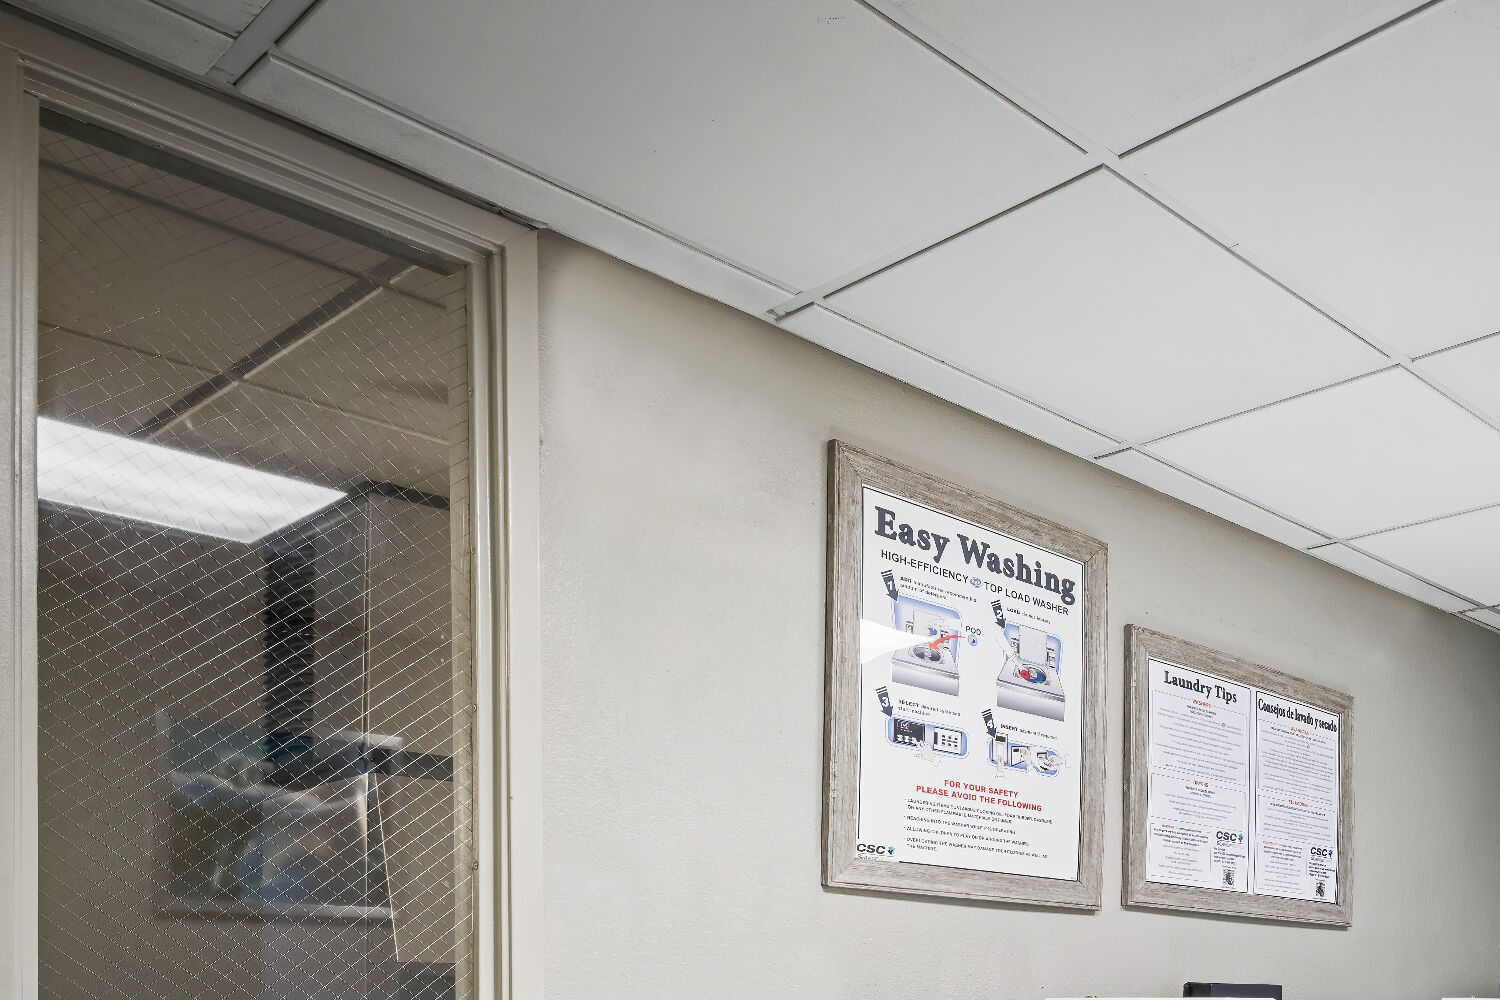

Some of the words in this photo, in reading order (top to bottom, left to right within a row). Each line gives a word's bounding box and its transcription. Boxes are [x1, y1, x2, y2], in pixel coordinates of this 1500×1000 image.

[874, 506, 950, 563] Easy
[957, 533, 1076, 606] Washing
[881, 549, 969, 585] HIGH-EFFICIENCY
[984, 581, 1003, 594] TOP
[1005, 588, 1030, 603] LOAD
[1033, 597, 1069, 616] WASHER
[965, 626, 982, 636] POD
[1164, 670, 1212, 700] Laundry
[1214, 685, 1238, 705] Tips
[1258, 698, 1286, 719] Consejos
[1286, 707, 1294, 720] de
[1294, 708, 1314, 726] lavado
[1314, 718, 1319, 730] y
[1318, 719, 1338, 733] secado
[916, 785, 949, 797] PLEASE
[951, 790, 977, 801] AVOID
[979, 795, 996, 804] THE
[997, 798, 1042, 812] FOLLOWING
[944, 779, 961, 789] FOR
[964, 782, 986, 793] YOUR
[988, 786, 1019, 798] SAFETY
[1216, 830, 1237, 841] CSC
[856, 843, 886, 855] CSC
[1310, 846, 1328, 857] CSC
